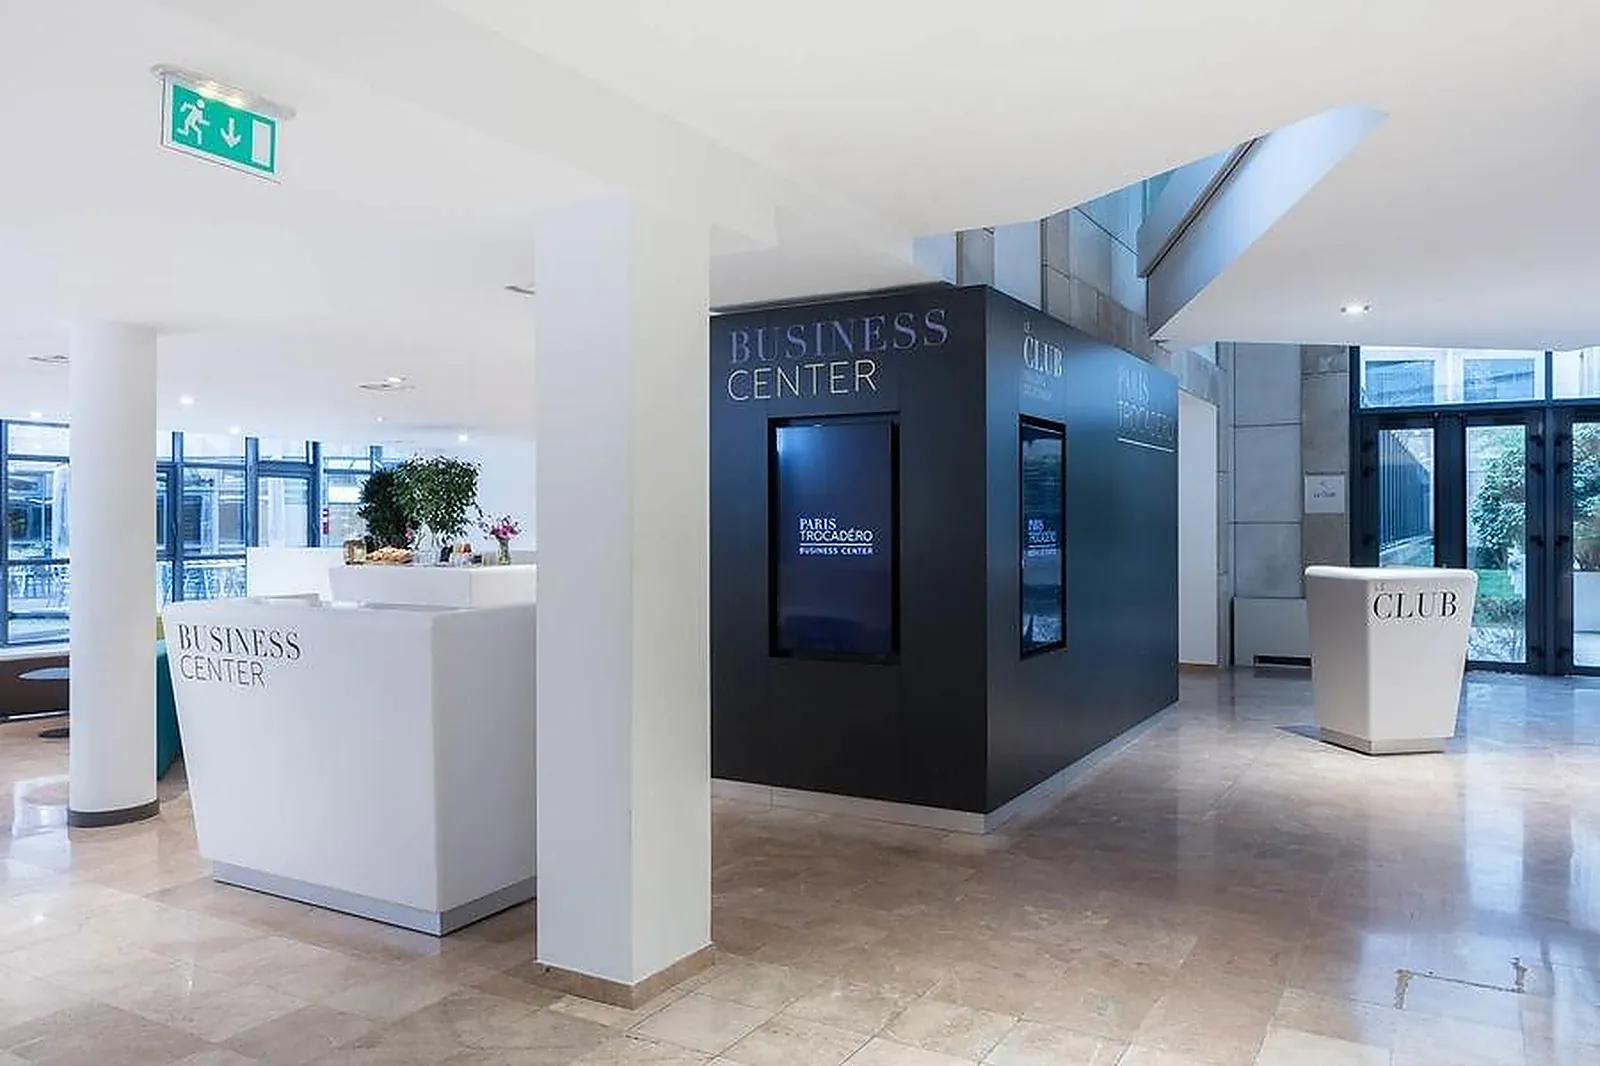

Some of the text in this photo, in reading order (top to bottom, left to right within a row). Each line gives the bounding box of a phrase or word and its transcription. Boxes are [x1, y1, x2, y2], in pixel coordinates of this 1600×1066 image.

[729, 307, 950, 364] BUSINESS
[1023, 335, 1063, 378] CLUB
[727, 358, 877, 401] CENTER
[800, 517, 837, 530] PARIS
[800, 527, 874, 542] TROCADÉRO
[841, 546, 874, 556] CENTER
[1373, 592, 1457, 619] CLUB
[178, 623, 301, 661] BUSINESS
[179, 654, 266, 688] CENTER
